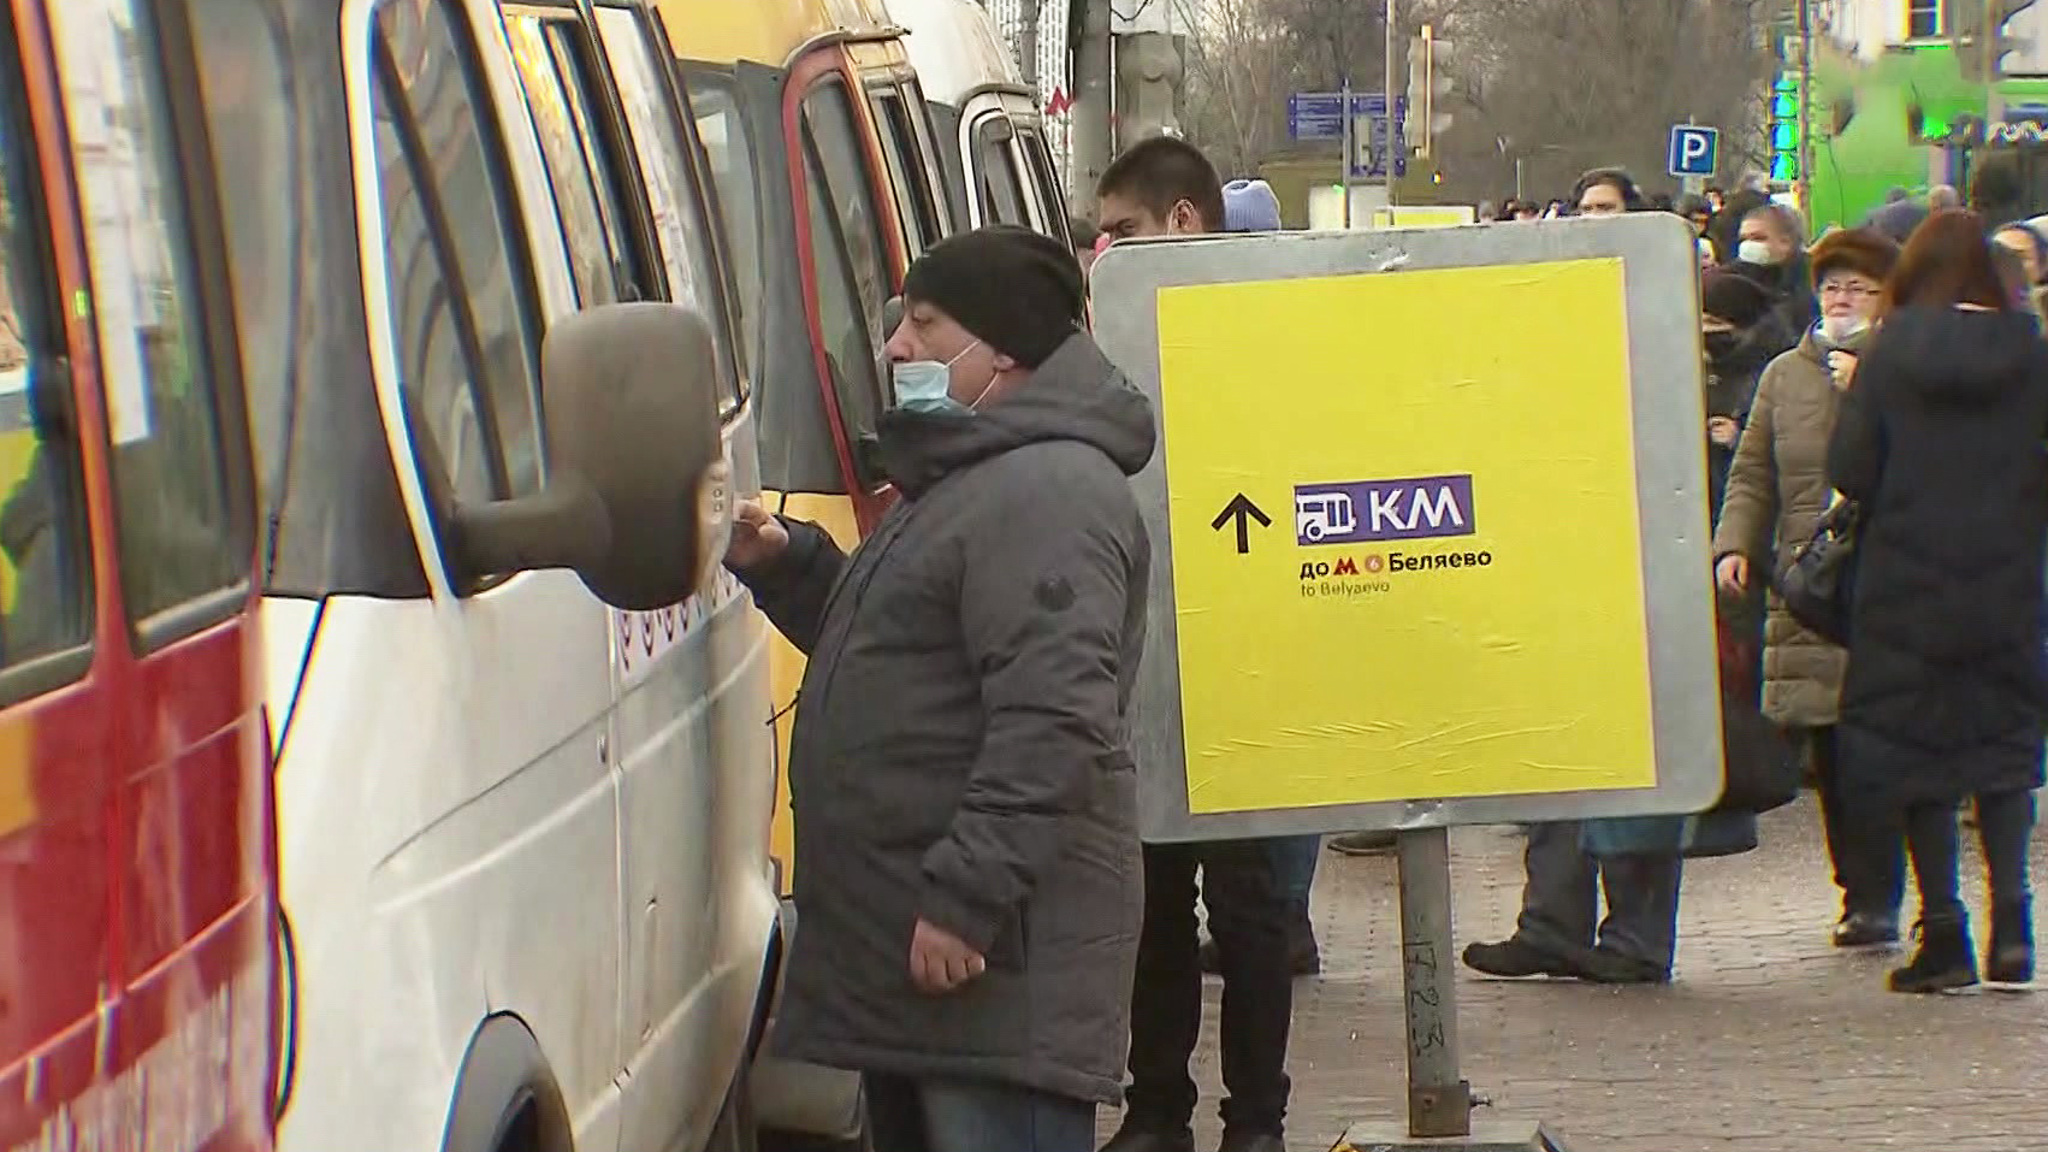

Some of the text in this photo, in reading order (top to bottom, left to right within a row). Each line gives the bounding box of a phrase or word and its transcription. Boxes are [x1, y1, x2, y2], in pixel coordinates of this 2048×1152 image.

[1682, 132, 1706, 169] P
[1370, 486, 1464, 532] КМ
[1300, 561, 1329, 580] до
[1389, 551, 1492, 572] Беляево
[1301, 580, 1390, 597] to Belyaevo
